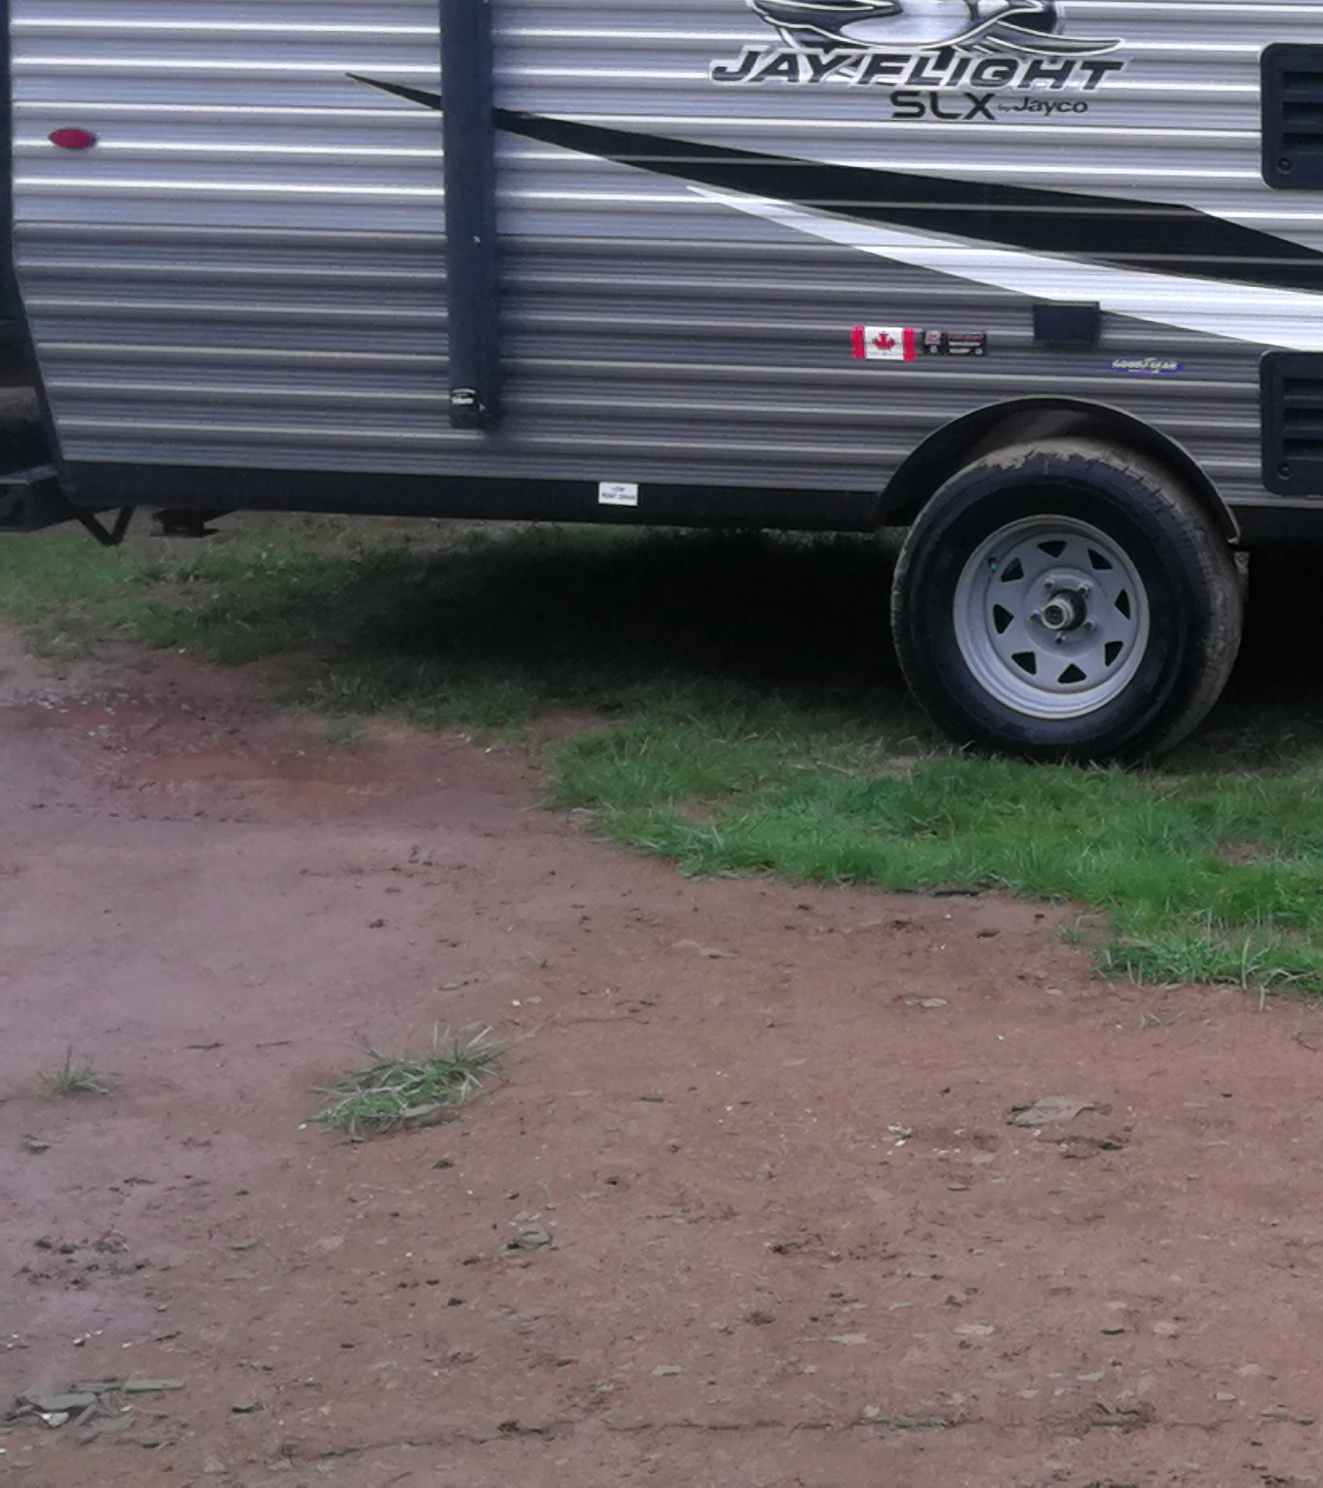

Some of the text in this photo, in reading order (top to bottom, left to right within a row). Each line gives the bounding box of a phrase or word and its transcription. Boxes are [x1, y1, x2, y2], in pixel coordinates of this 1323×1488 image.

[711, 48, 1127, 91] JAY FLIGHT
[889, 91, 1089, 121] SLX Jayco
